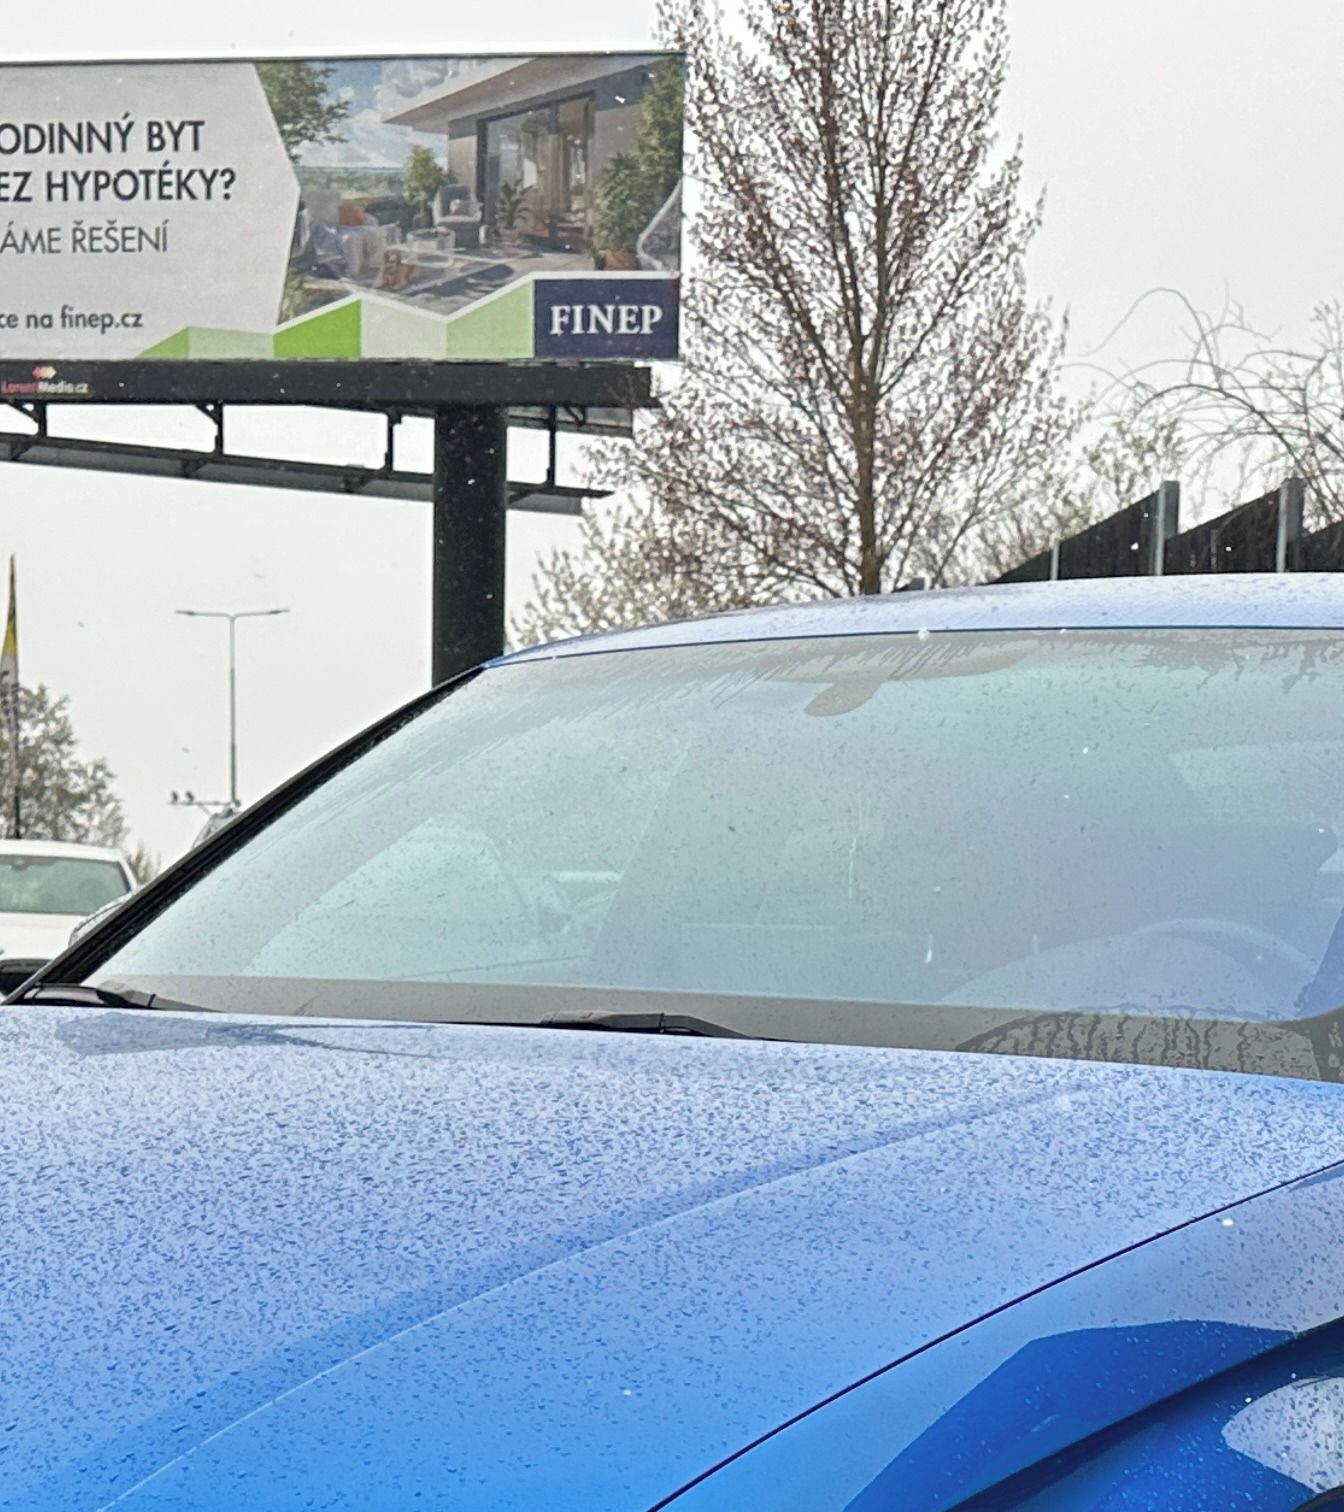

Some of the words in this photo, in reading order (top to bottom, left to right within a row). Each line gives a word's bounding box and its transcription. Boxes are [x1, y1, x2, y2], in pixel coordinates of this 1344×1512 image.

[147, 120, 205, 152] BYT
[46, 160, 236, 202] HYPOTÉKY?
[71, 219, 169, 254] ŘEŠENÍ
[26, 313, 53, 329] na
[61, 304, 144, 335] finep.cz
[549, 304, 663, 335] FINEP
